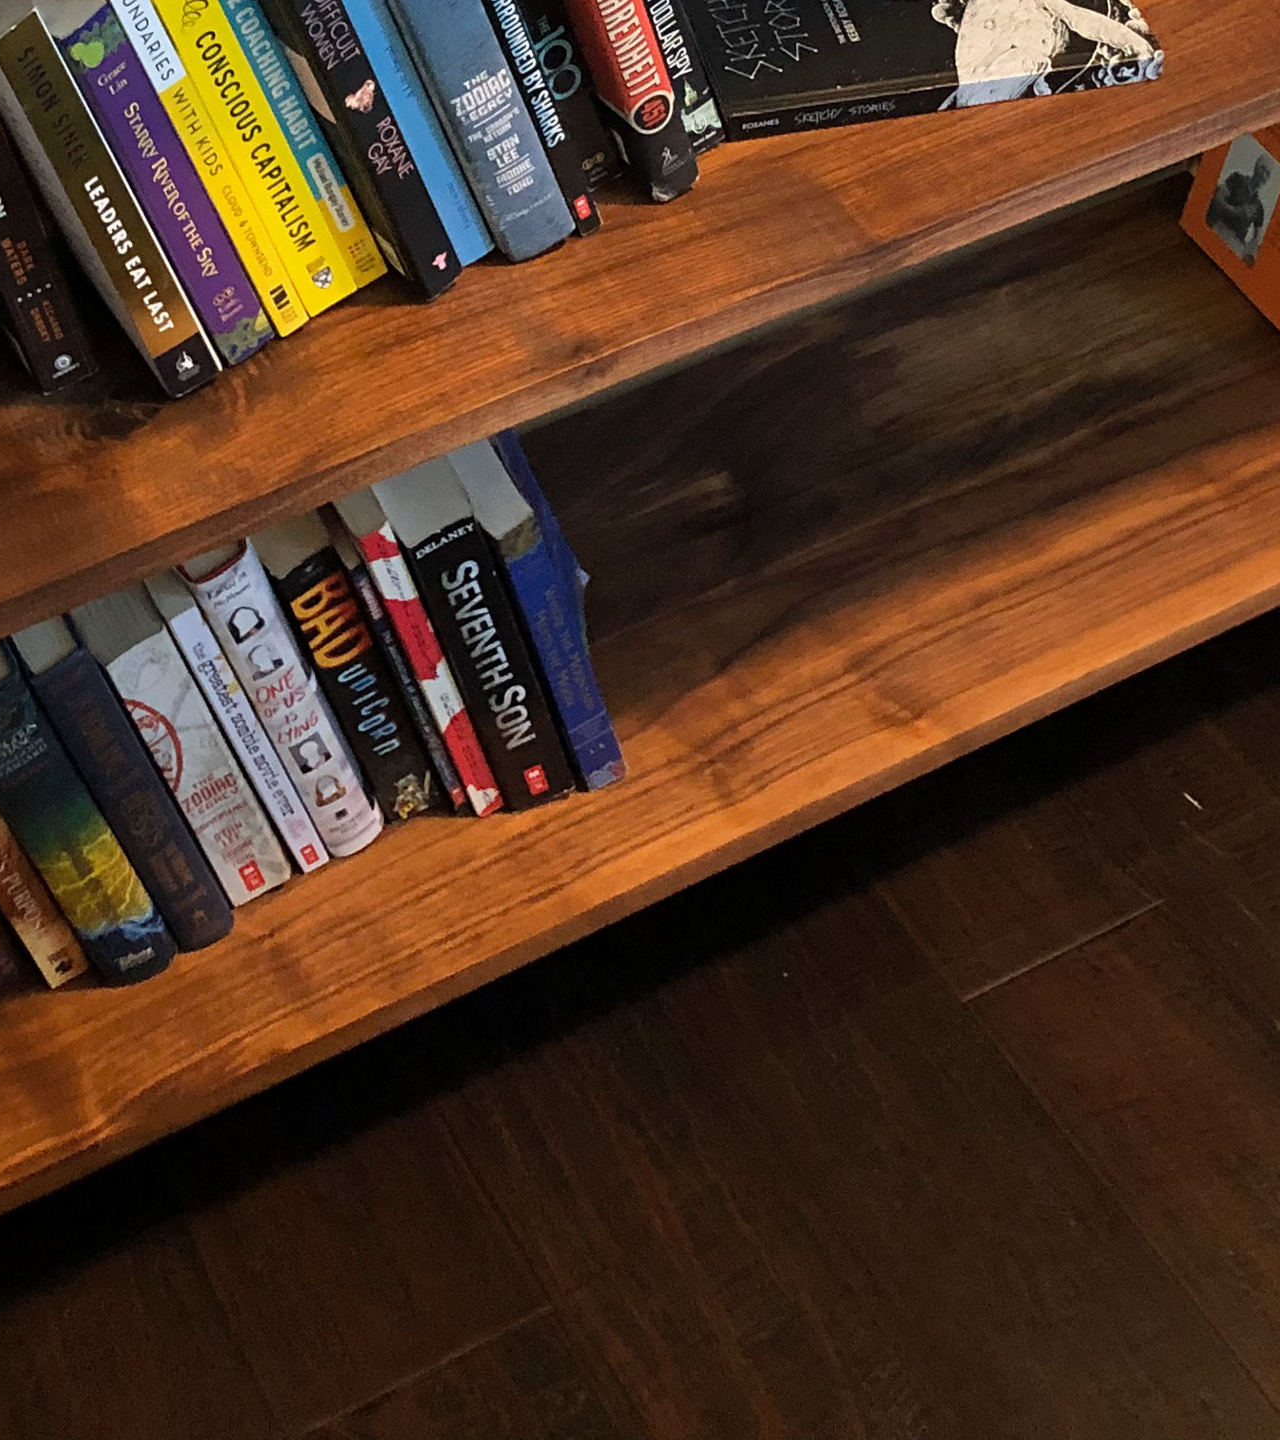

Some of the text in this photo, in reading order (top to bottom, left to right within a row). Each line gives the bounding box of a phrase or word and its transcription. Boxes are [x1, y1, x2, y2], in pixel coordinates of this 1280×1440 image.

[300, 2, 338, 71] WOMEN
[537, 13, 551, 36] THE
[17, 44, 60, 114] SIMON
[96, 60, 128, 88] Grace
[234, 2, 292, 100] COACHING
[276, 91, 318, 152] HABIT
[462, 69, 489, 91] THE
[533, 23, 582, 100] 100
[665, 45, 693, 81] SPY
[107, 77, 129, 96] Lin
[450, 67, 511, 118] ZODIAC
[522, 66, 545, 97] BY
[460, 87, 513, 126] LEGACY
[531, 88, 566, 150] SHARKS
[641, 97, 668, 130] 451
[741, 117, 780, 131] ROSANES
[793, 99, 897, 126] SKETCHY STORIES
[170, 85, 224, 178] WITH KIDS
[194, 29, 318, 254] CONSCIOUS CAPITALISM
[375, 115, 415, 180] ROXANE
[486, 132, 521, 162] STAN
[367, 141, 393, 176] GAY
[496, 147, 521, 170] LEE
[123, 101, 219, 279] STARRY RIVER OF THE SKY
[220, 184, 244, 220] CLOUD
[241, 225, 275, 279] TOWNSEND
[0, 236, 28, 286] WATERS
[16, 239, 35, 271] DARK
[83, 175, 175, 334] LEADERS EAT LAST
[414, 521, 476, 560] DELANEY
[290, 573, 372, 668] BAD
[440, 559, 515, 691] SEVENTH
[487, 684, 537, 751] SON
[254, 665, 296, 706] ONE
[282, 686, 308, 709] US
[190, 641, 296, 818] the greatest zombie movie ever
[276, 709, 319, 746] LYING
[284, 711, 299, 726] IS
[182, 771, 238, 812] ZODIAC
[191, 772, 215, 791] THE
